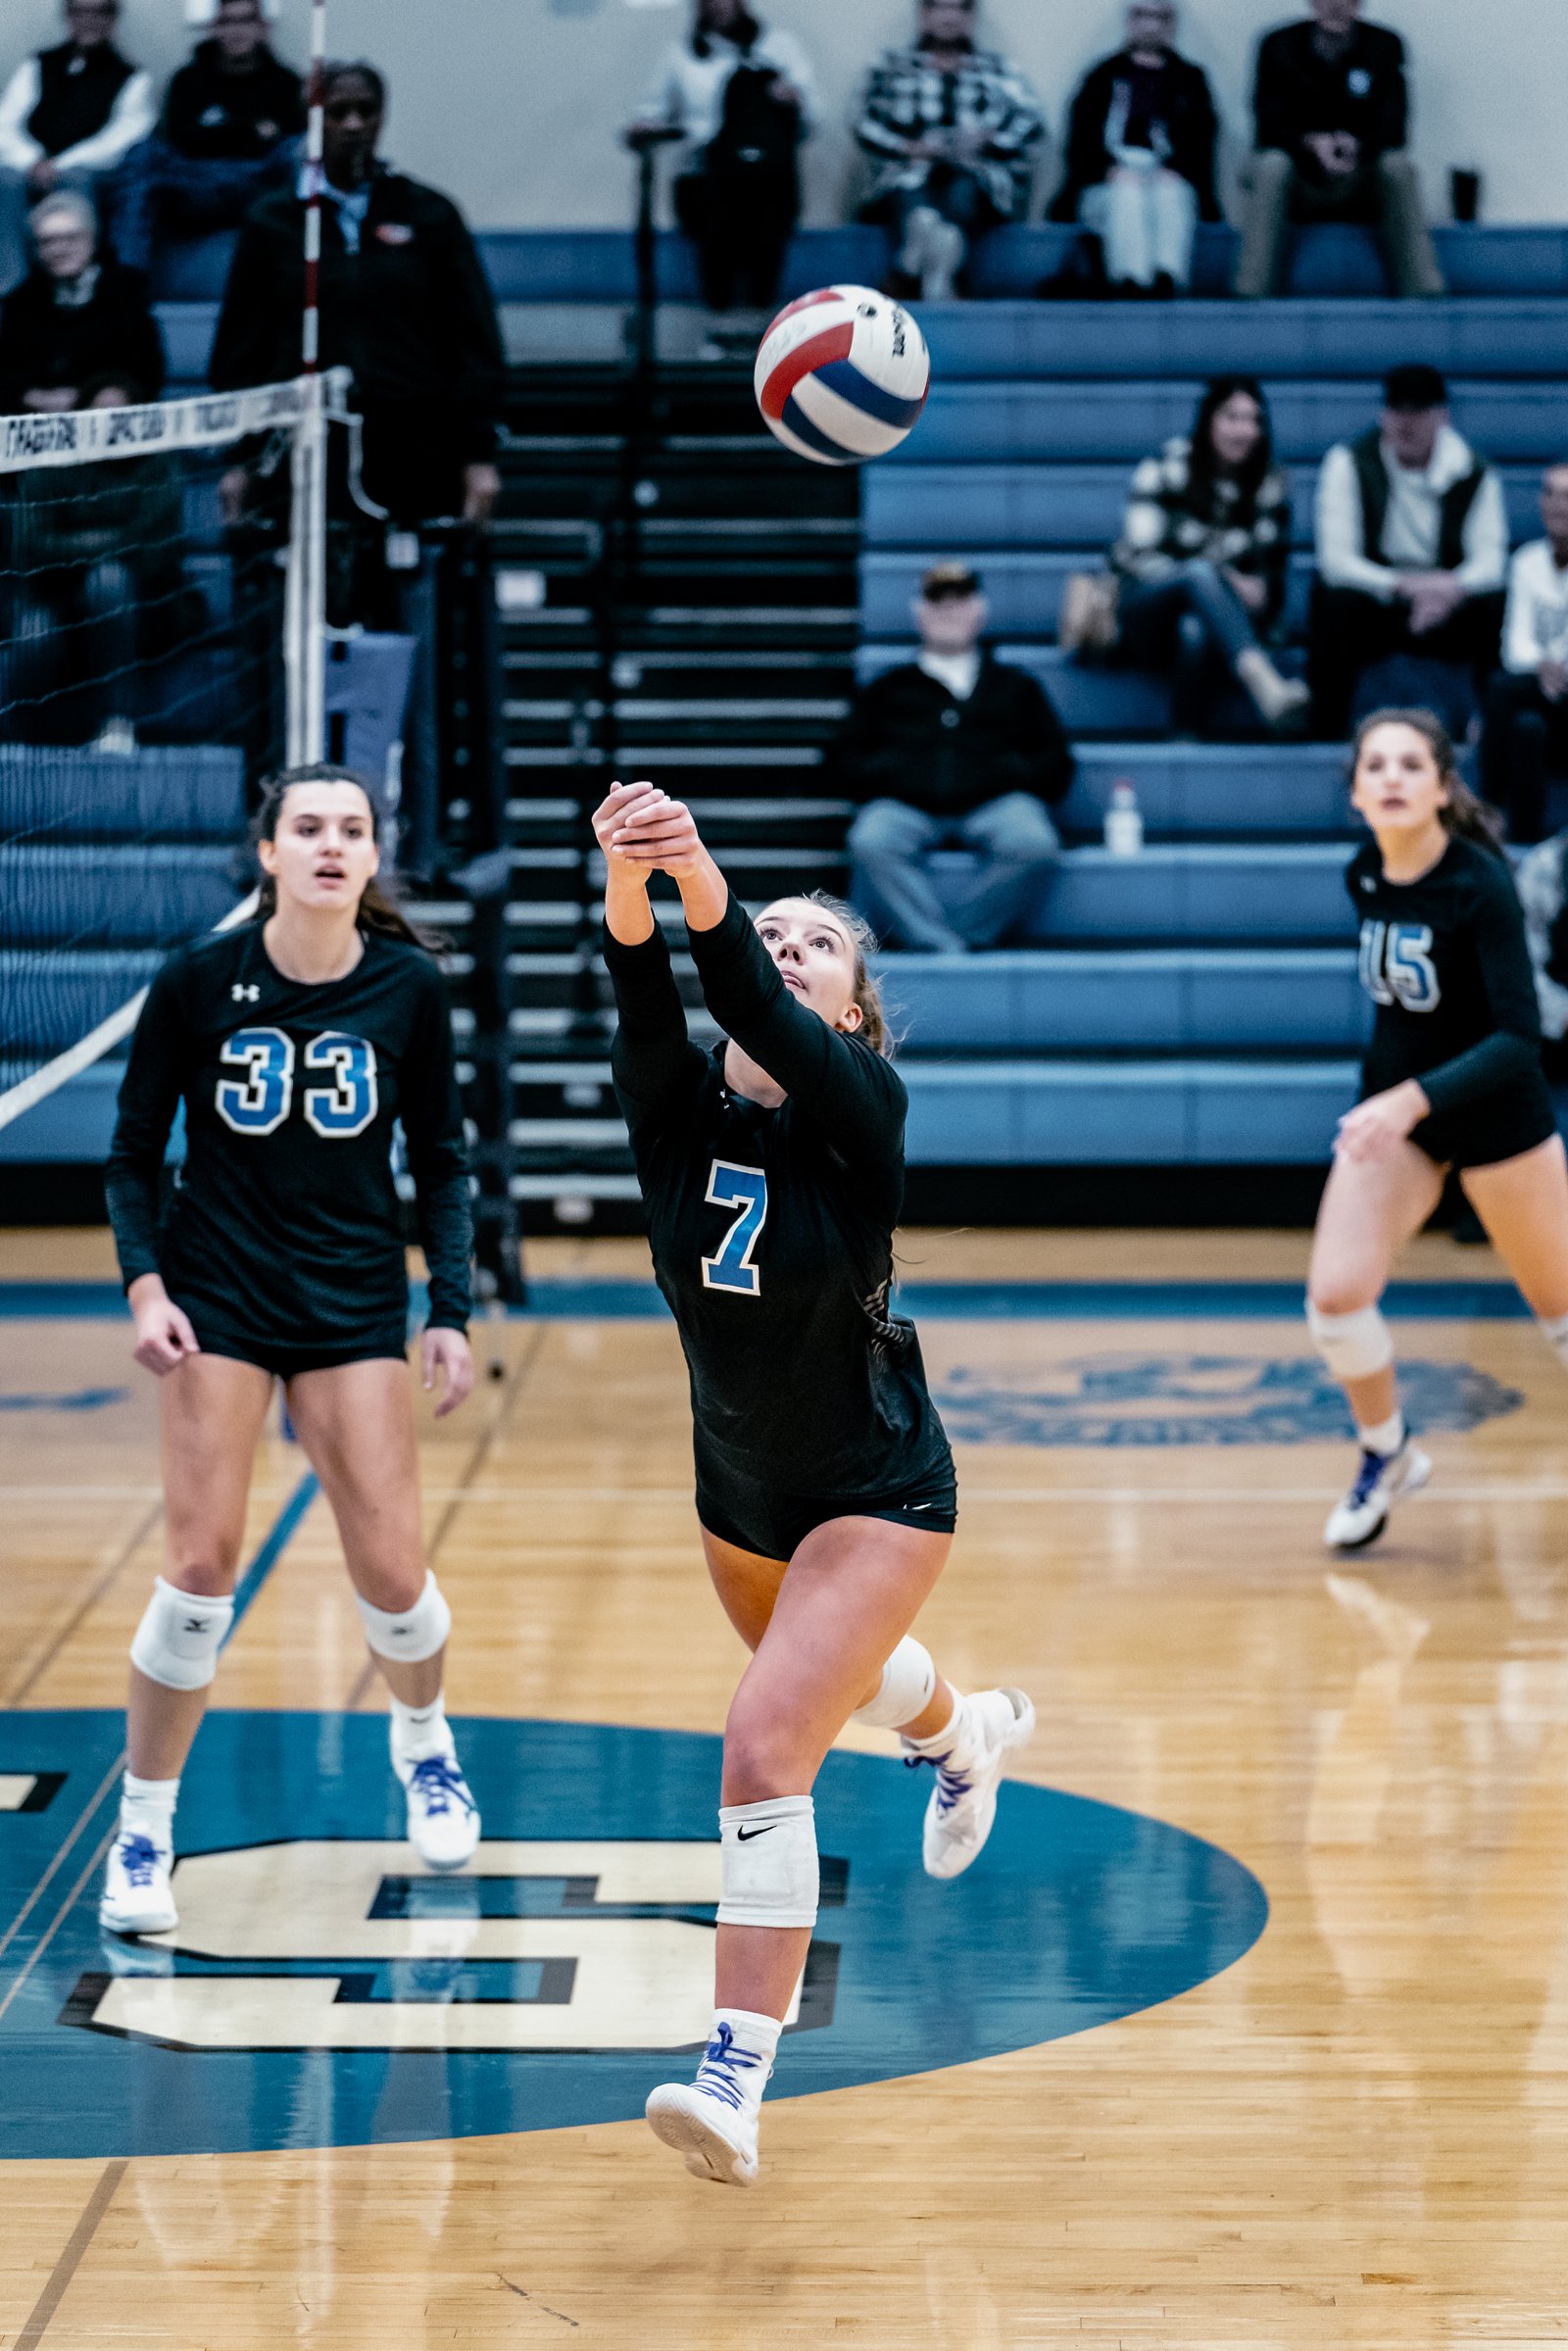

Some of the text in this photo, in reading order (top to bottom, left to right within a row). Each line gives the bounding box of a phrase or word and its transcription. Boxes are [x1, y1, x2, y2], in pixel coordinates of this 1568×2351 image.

[1358, 918, 1442, 1012] 15
[215, 1027, 378, 1139] 33
[701, 1158, 767, 1296] 7
